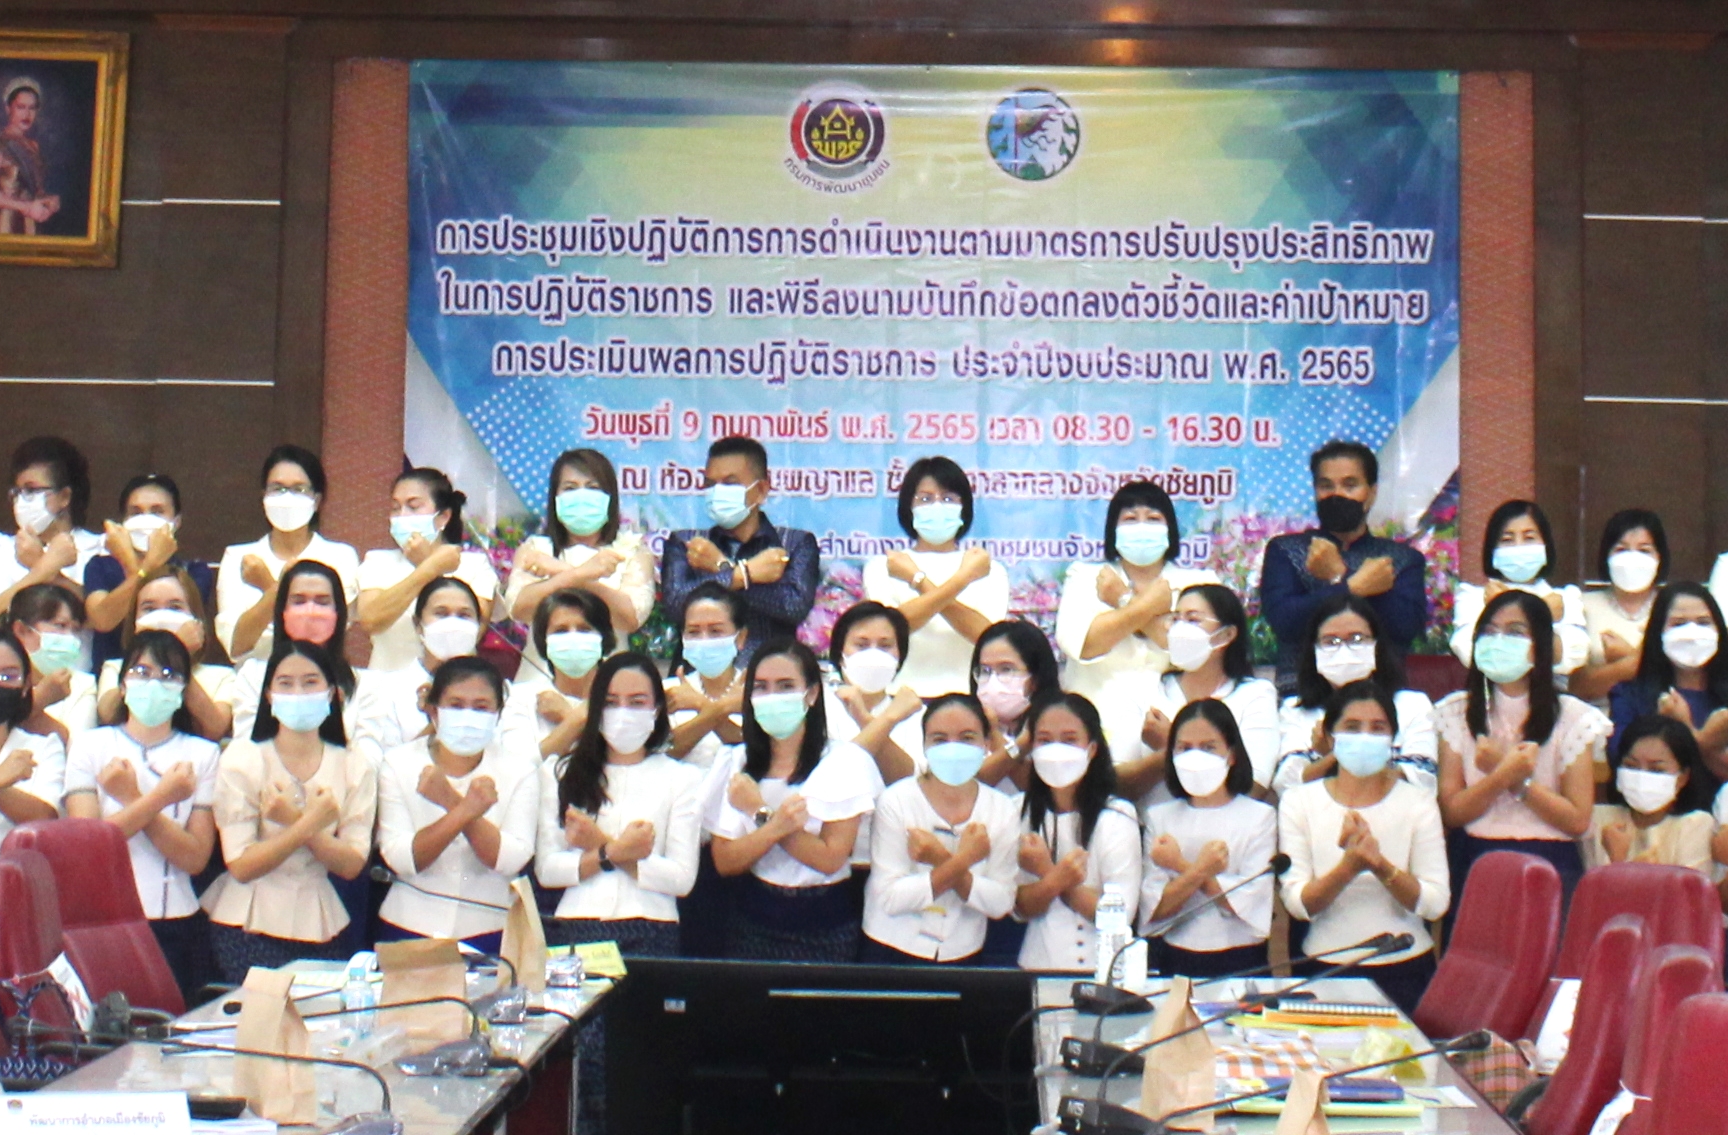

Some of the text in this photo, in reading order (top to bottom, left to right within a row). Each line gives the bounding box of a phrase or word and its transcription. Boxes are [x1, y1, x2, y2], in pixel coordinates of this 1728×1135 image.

[439, 271, 713, 322] ในการปฏิบัติราชการ
[496, 339, 1373, 383] การประเมินผลการปฏิบัติราชการ ประจำปีงบประมาณ พ.ศ. 2565
[586, 402, 670, 443] วันพุธที่
[683, 411, 699, 436] 9
[712, 409, 829, 438] กมภาพันธ์
[842, 413, 894, 438] พ.ศ.
[907, 413, 975, 439] 2565
[1053, 414, 1130, 441] 08.30
[1168, 416, 1242, 442] 16.30
[1255, 419, 1278, 442] น.
[623, 468, 647, 490] ณ
